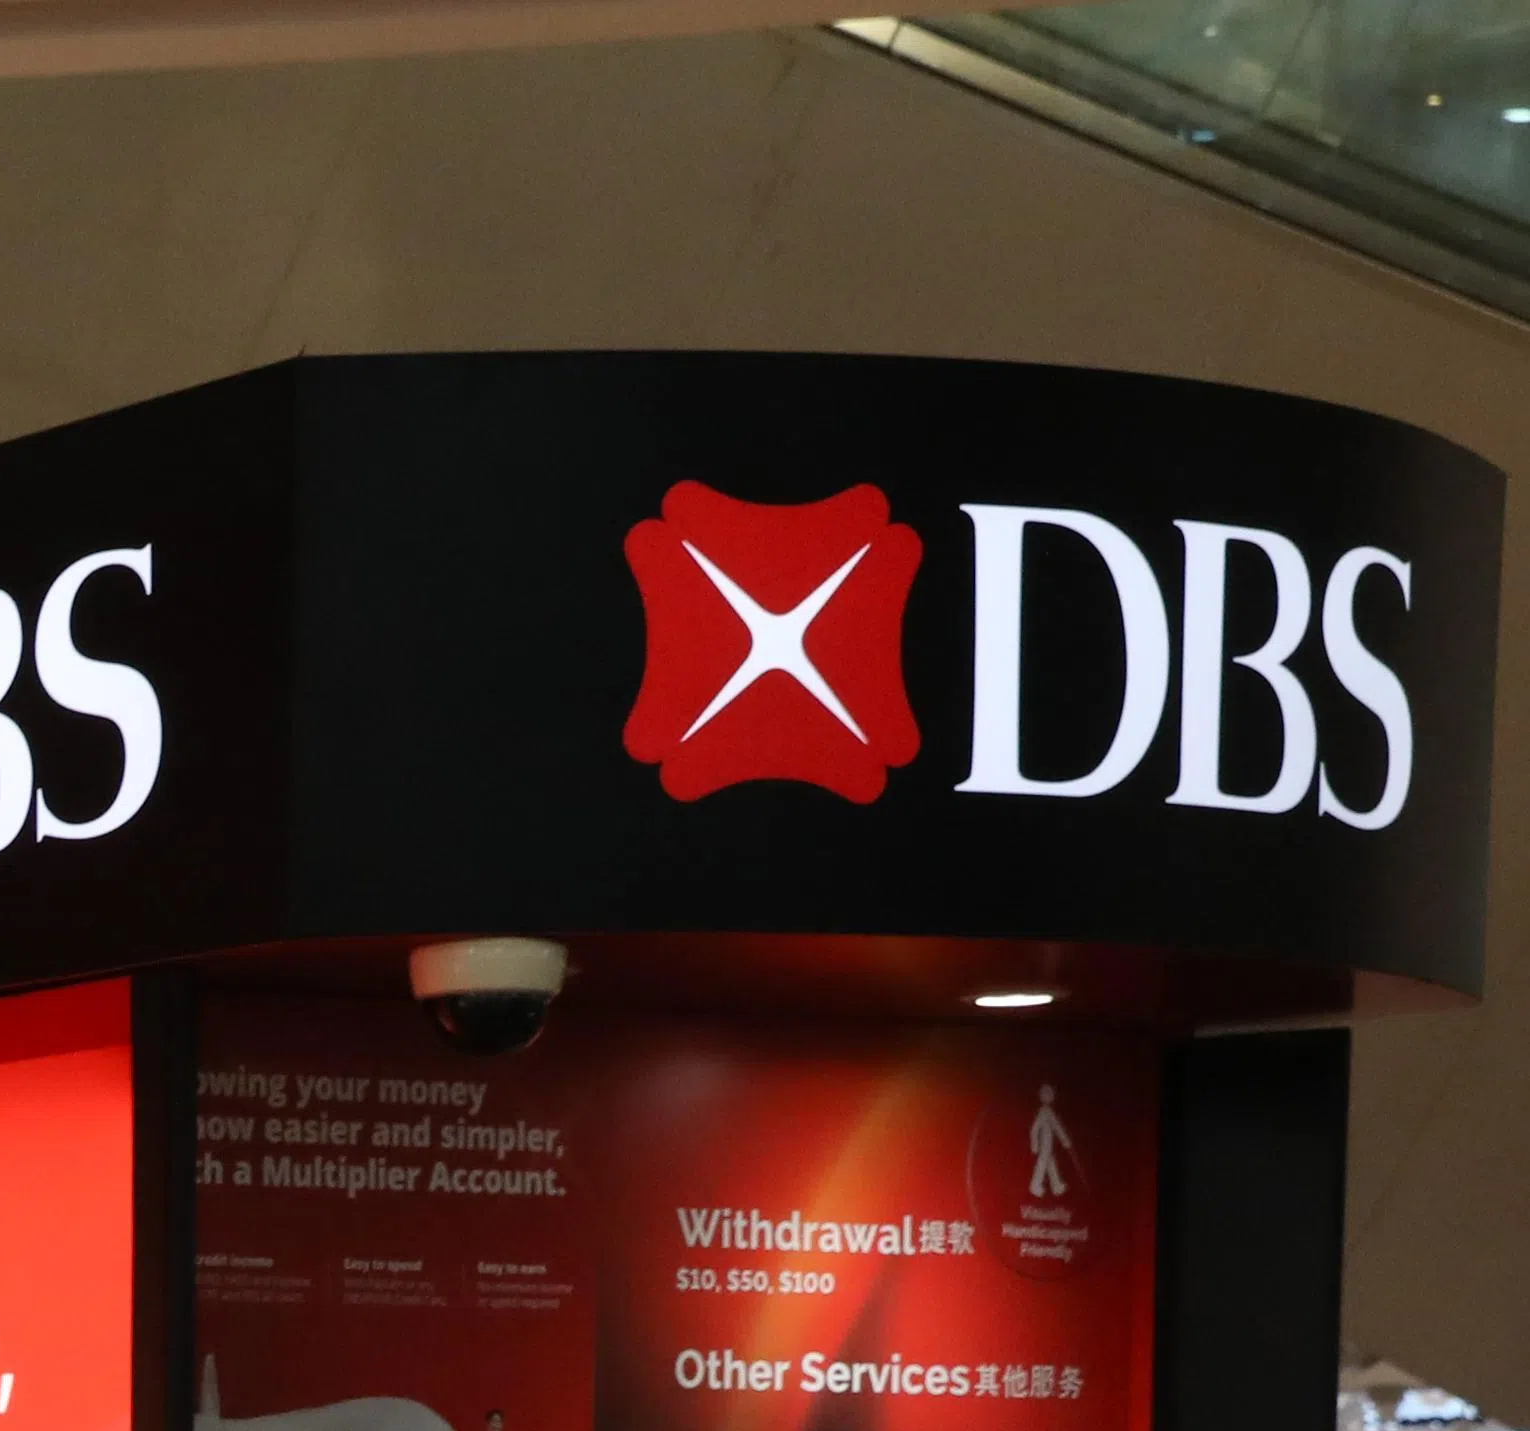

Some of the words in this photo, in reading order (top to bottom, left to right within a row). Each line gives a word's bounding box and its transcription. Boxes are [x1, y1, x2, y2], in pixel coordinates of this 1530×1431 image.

[955, 503, 1413, 830] DBS
[296, 1074, 370, 1108] your
[378, 1078, 486, 1115] money
[265, 1113, 362, 1146] easier
[371, 1117, 431, 1149] and
[441, 1117, 566, 1160] simpler,
[233, 1162, 252, 1185] a
[263, 1156, 420, 1198] Multiplier
[429, 1160, 567, 1197] Account.
[677, 1208, 915, 1256] Withdrawal
[676, 1268, 722, 1294] $10,
[727, 1269, 775, 1295] $50,
[779, 1271, 836, 1295] $100
[675, 1349, 790, 1391] Other
[800, 1353, 970, 1397] Services
